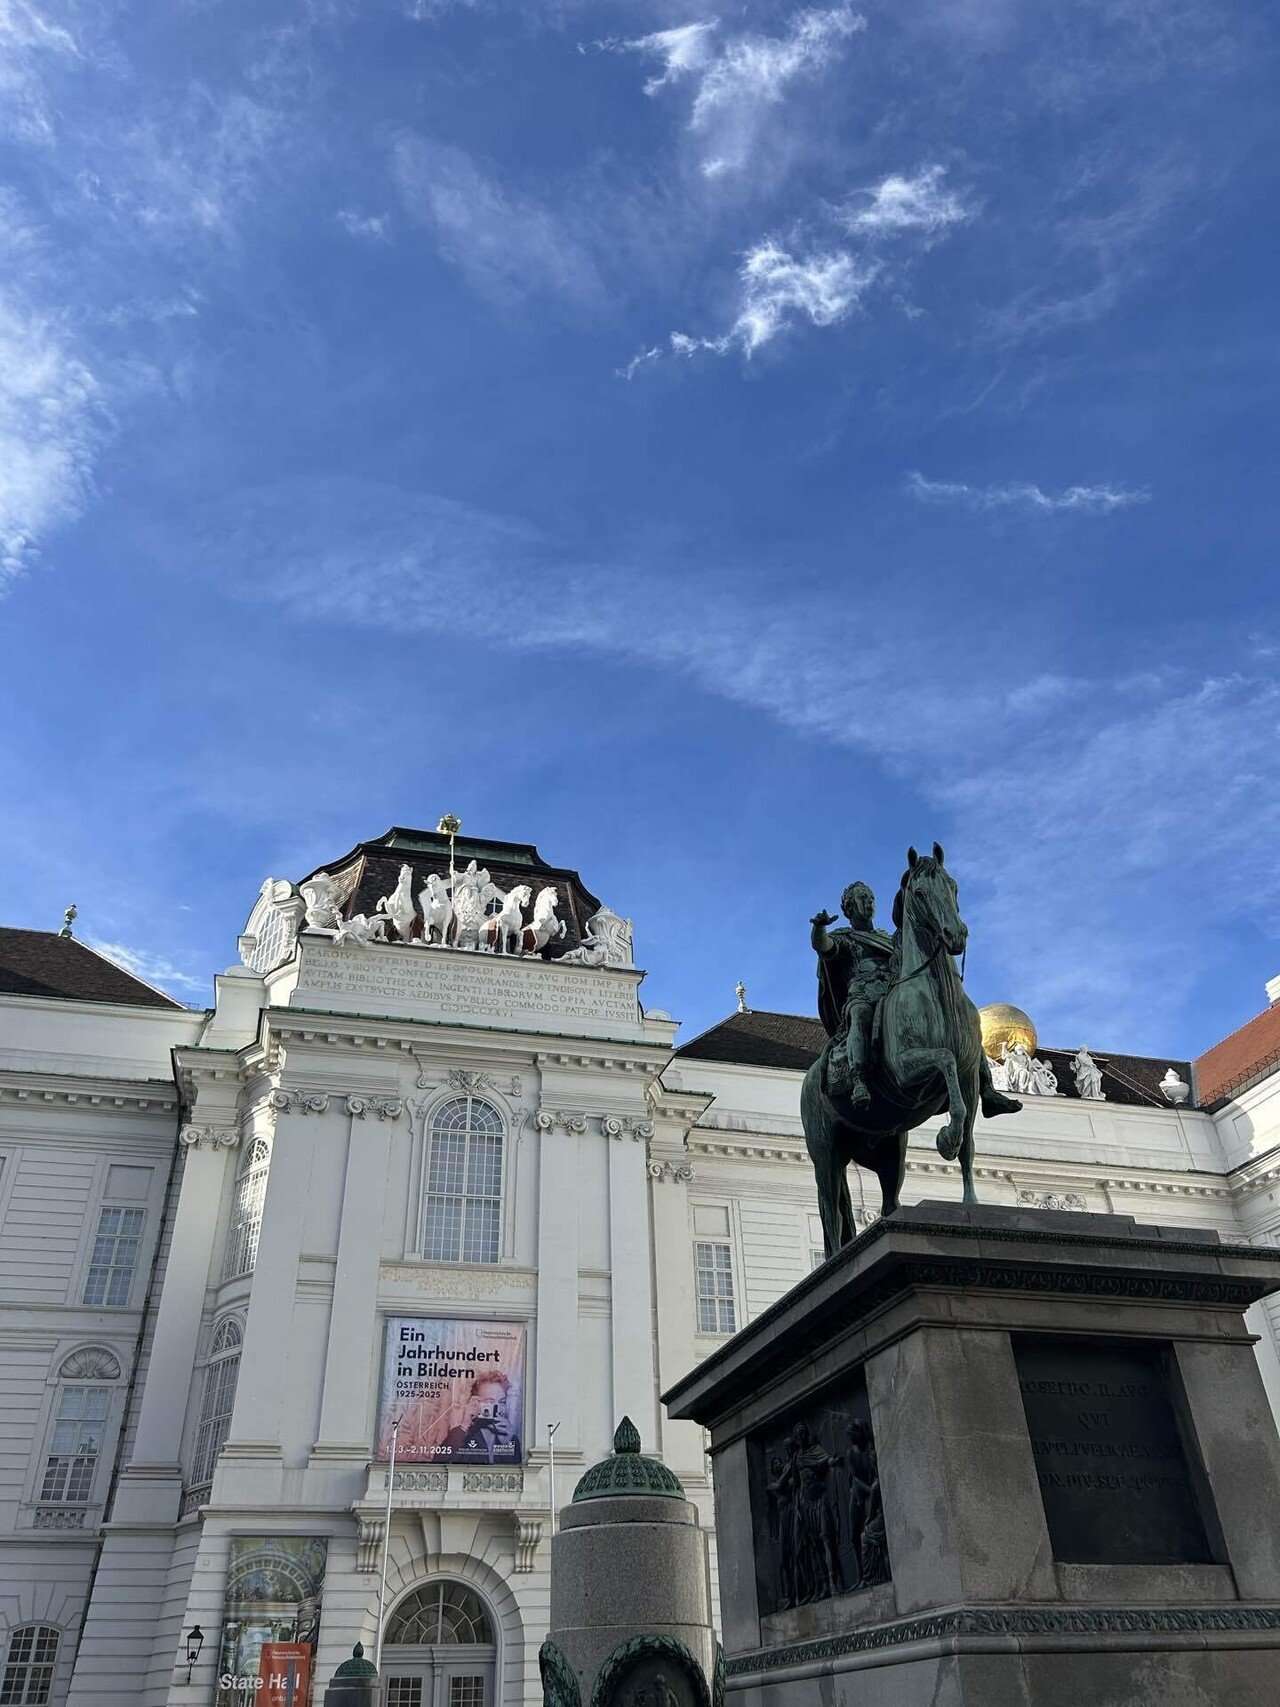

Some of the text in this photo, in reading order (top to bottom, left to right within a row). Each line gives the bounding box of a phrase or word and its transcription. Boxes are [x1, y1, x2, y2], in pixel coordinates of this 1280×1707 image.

[504, 999, 560, 1012] COMMODO
[400, 1327, 425, 1342] Ein
[398, 1345, 500, 1362] Jahrhundert
[397, 1362, 475, 1379] in Bildern
[220, 1673, 301, 1690] State Hal
